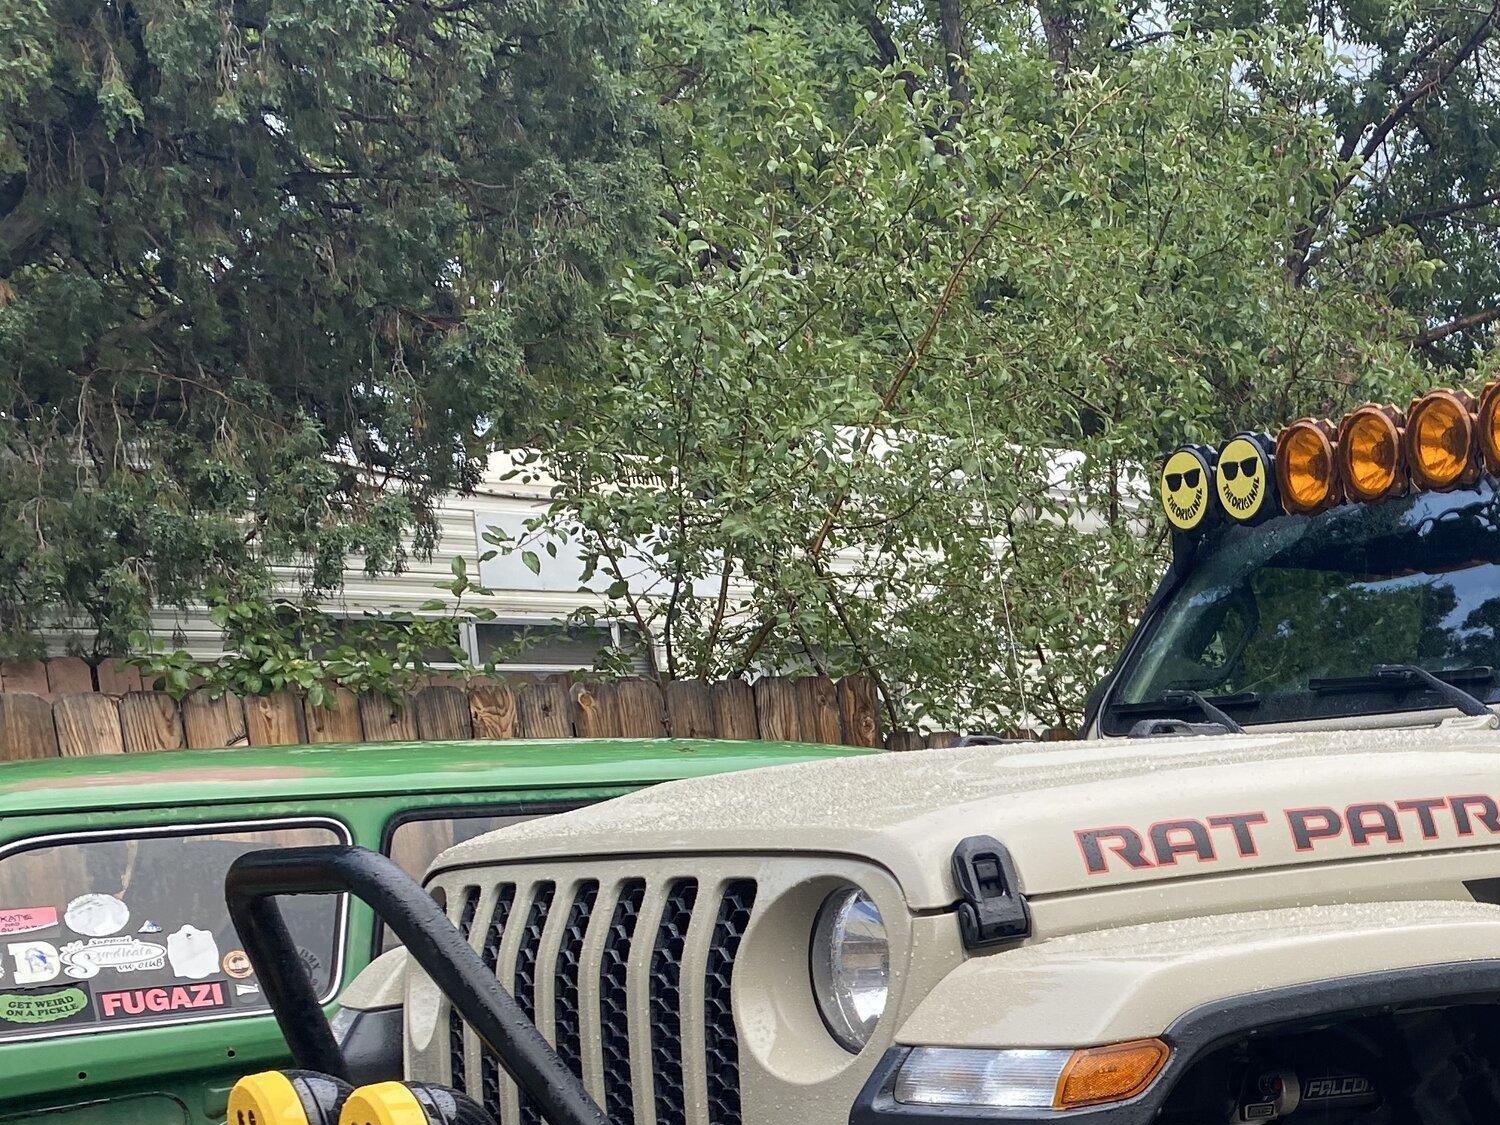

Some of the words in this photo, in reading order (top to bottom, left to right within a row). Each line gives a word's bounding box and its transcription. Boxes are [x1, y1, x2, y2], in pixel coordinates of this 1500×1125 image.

[1073, 810, 1269, 876] RAT
[6, 1008, 23, 1016] ON
[24, 1008, 35, 1016] A
[37, 1004, 79, 1016] PICKLE
[8, 1001, 32, 1009] GET
[34, 995, 75, 1007] WEIRD
[100, 982, 224, 1017] FUGAZI
